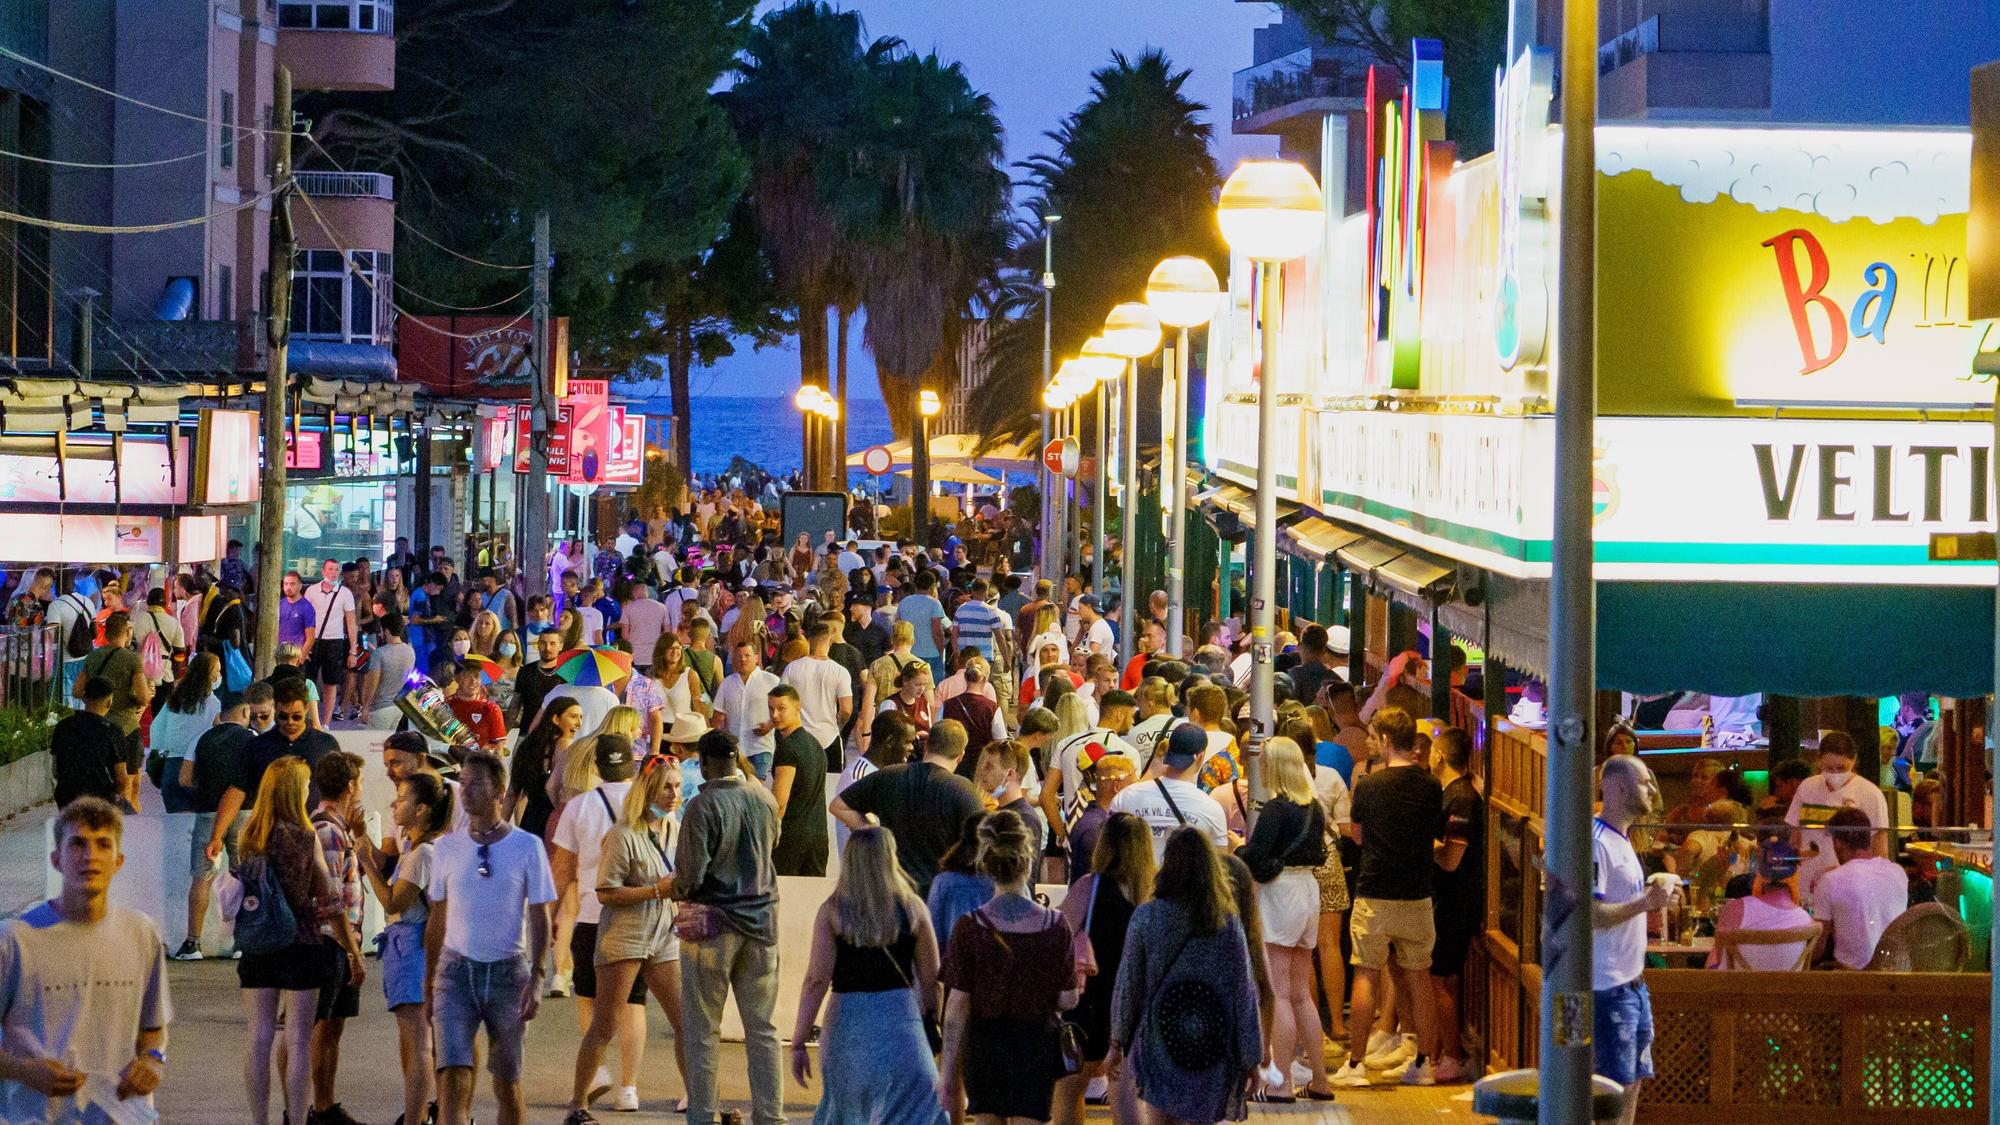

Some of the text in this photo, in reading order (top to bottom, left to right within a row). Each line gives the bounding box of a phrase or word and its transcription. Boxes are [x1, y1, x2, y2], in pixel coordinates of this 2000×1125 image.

[567, 382, 605, 395] ACHTCLUB
[1047, 452, 1060, 461] ST
[1752, 443, 1989, 522] VELTI
